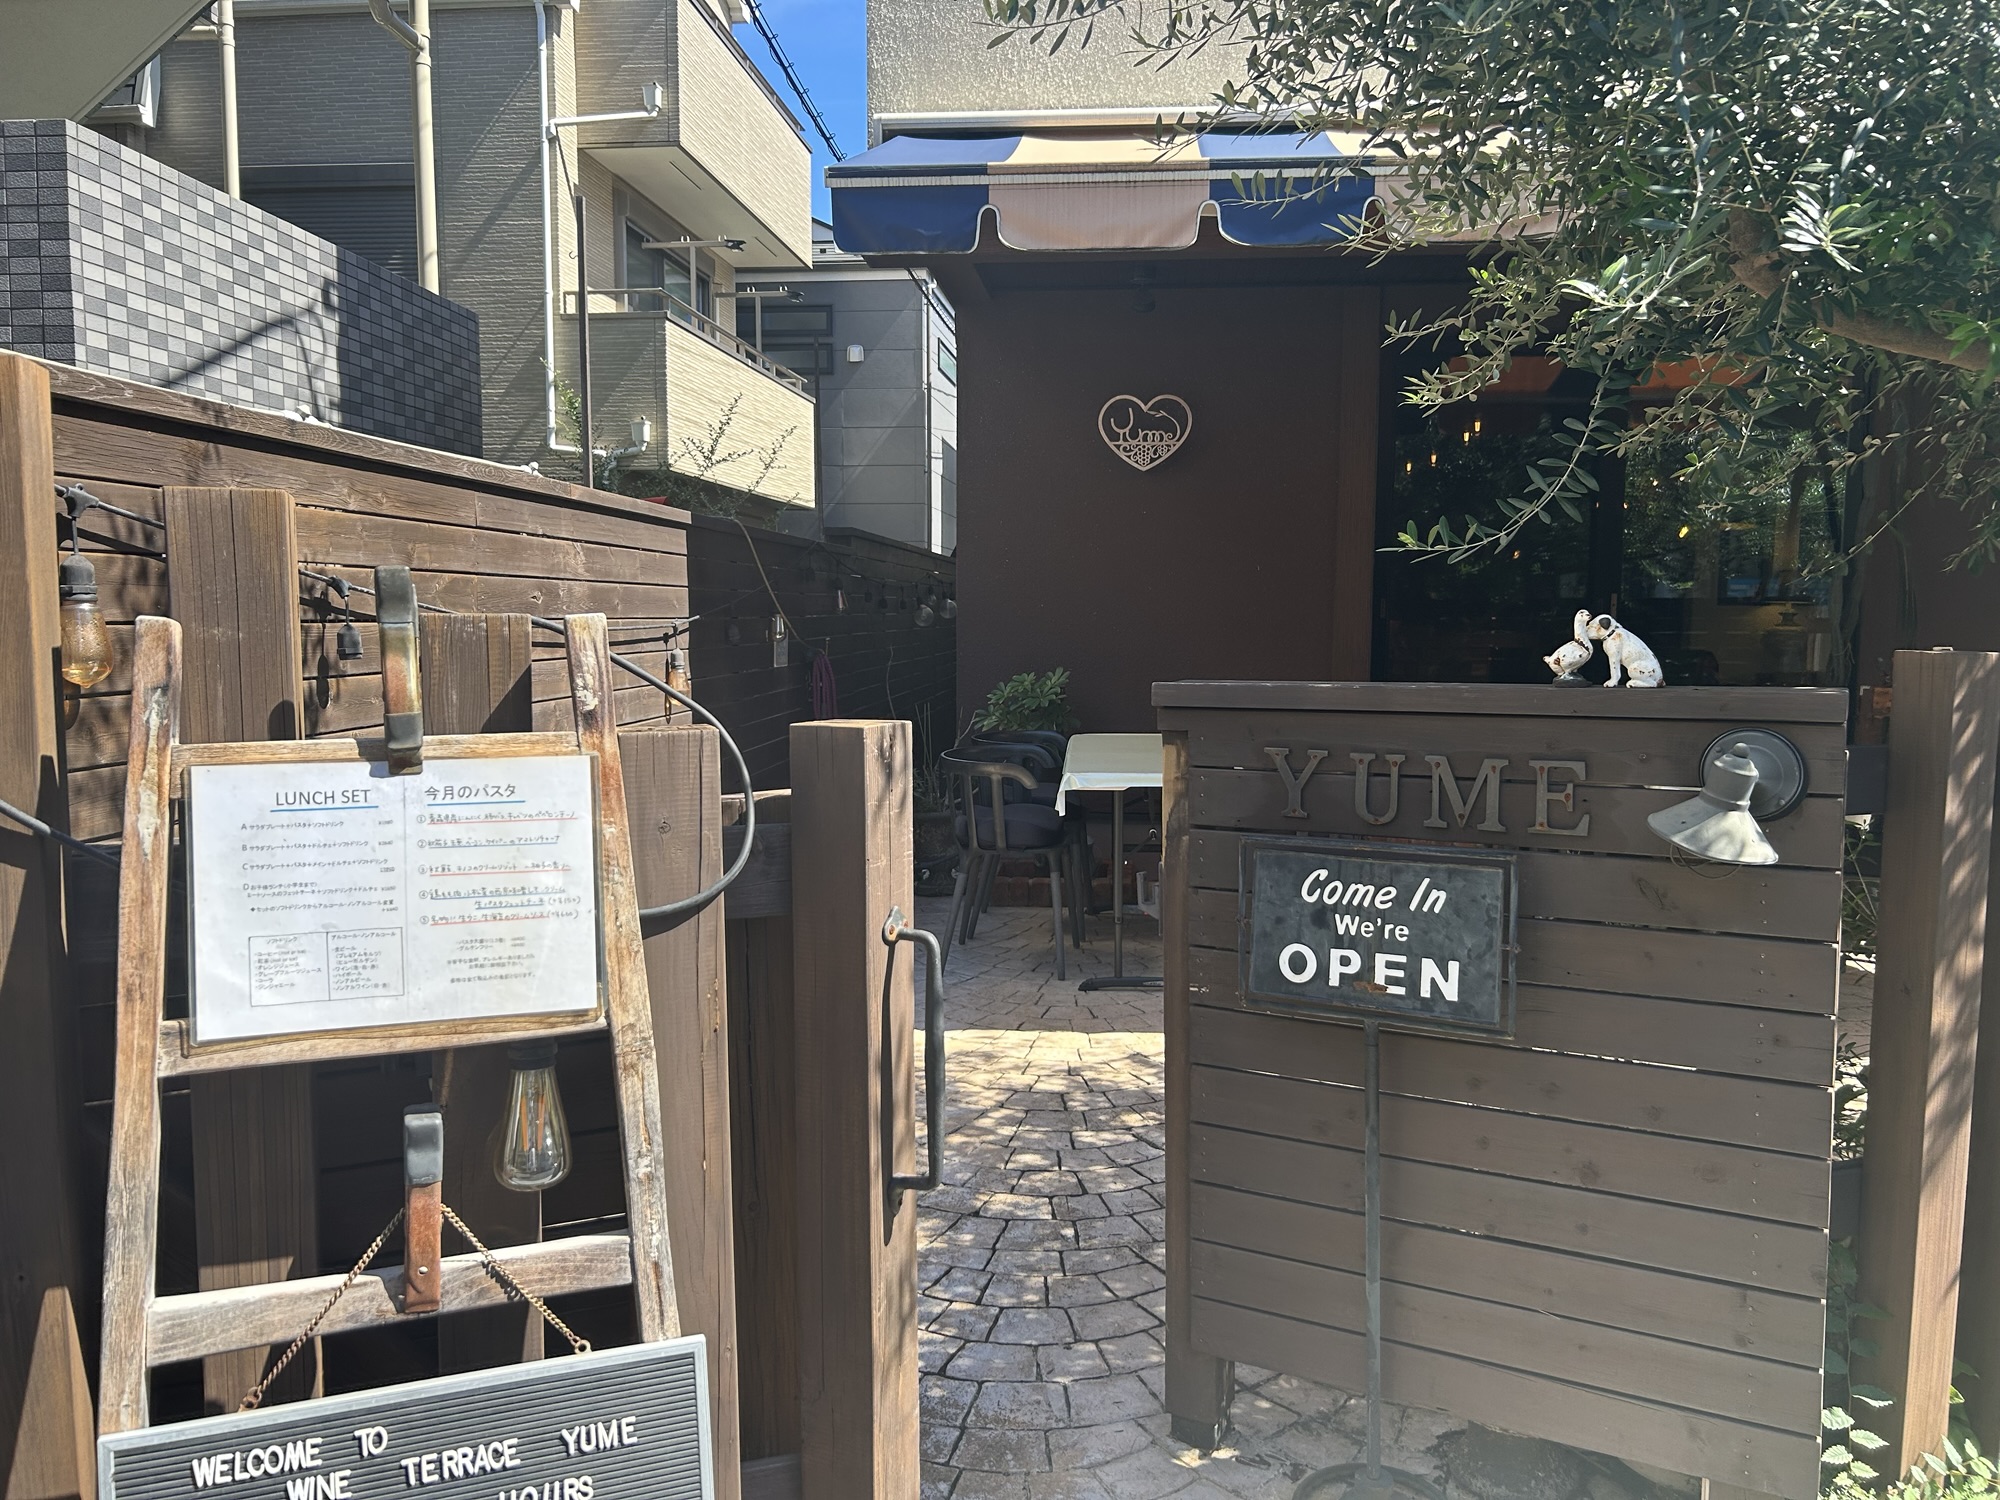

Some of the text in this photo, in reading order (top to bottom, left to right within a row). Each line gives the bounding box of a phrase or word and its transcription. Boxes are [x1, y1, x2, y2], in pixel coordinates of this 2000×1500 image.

[276, 789, 371, 806] LUNCH SET
[424, 784, 516, 801] 今月のパスタ
[1264, 747, 1590, 837] YUME
[1301, 868, 1447, 913] Come In
[1334, 913, 1409, 941] We're
[1278, 943, 1460, 1002] OPEN
[192, 1426, 388, 1487] WELCOME TO
[286, 1416, 638, 1500] WINE TERRACE YUME
